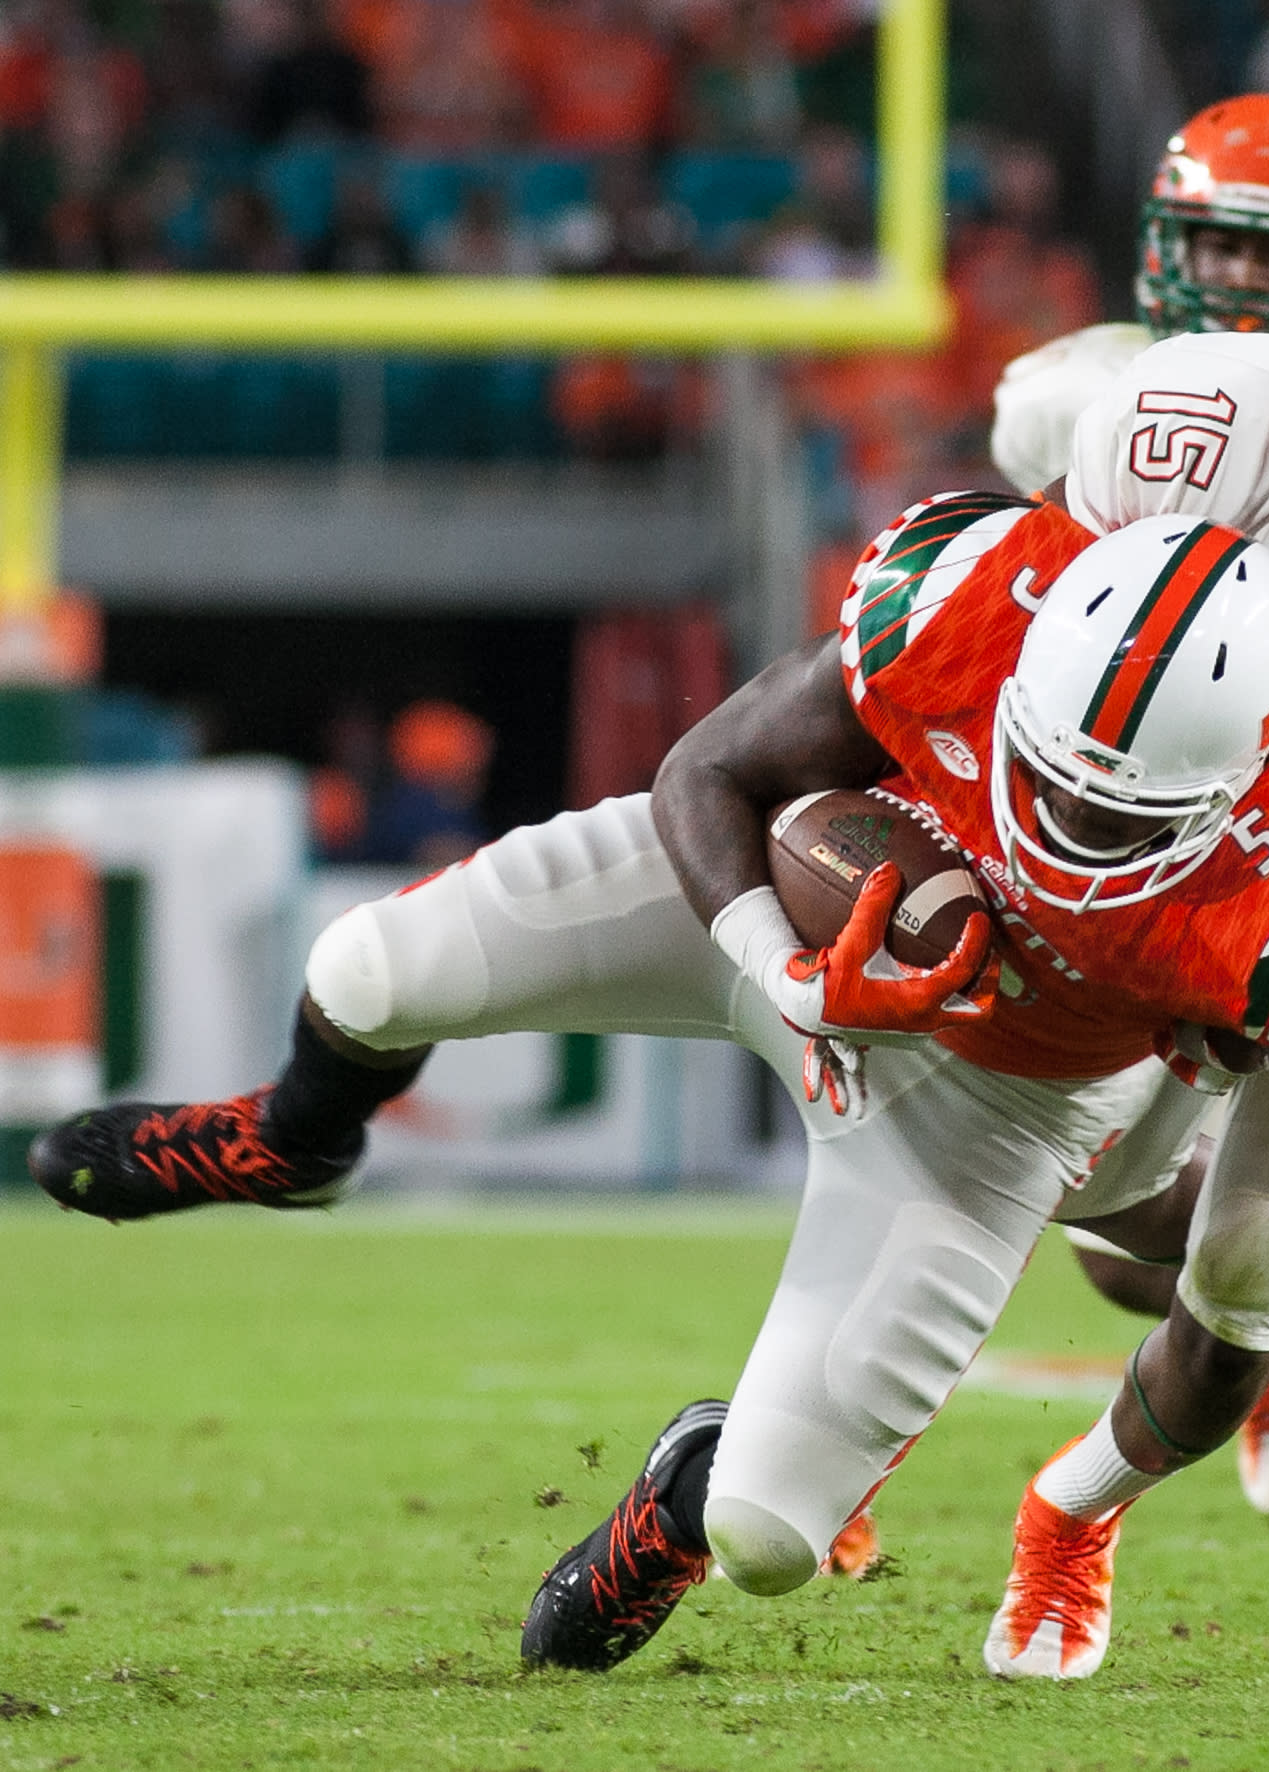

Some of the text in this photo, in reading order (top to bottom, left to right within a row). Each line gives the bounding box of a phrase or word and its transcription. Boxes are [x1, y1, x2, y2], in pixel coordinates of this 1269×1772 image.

[1130, 388, 1237, 491] 15
[932, 737, 977, 774] ACC
[828, 816, 886, 862] adidas
[809, 842, 863, 883] DIME
